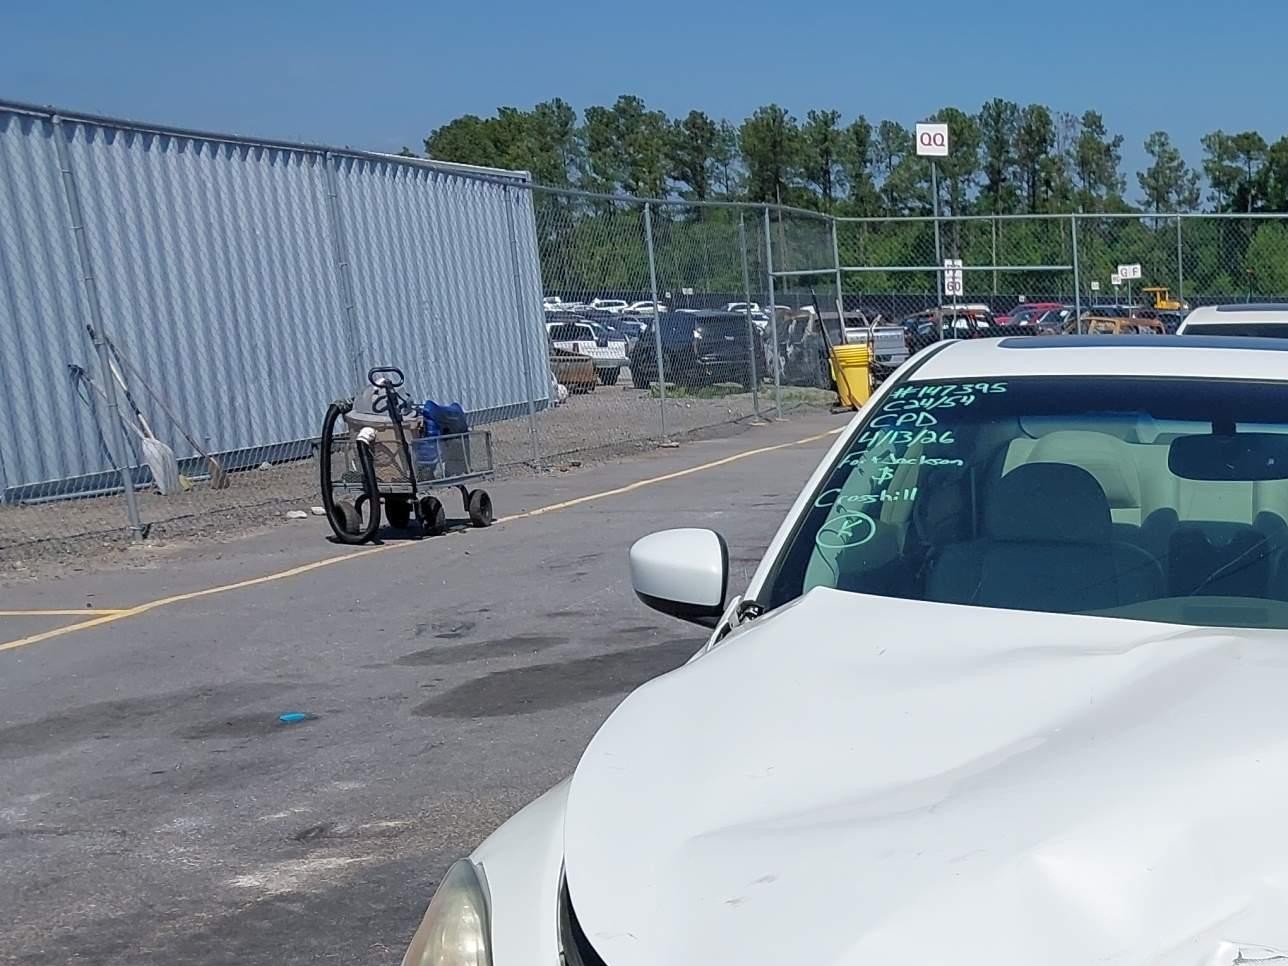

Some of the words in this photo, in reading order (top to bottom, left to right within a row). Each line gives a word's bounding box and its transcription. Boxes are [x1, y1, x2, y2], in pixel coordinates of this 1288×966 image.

[920, 131, 945, 147] QQ
[869, 411, 938, 428] CPD
[857, 429, 956, 447] 4/13/26
